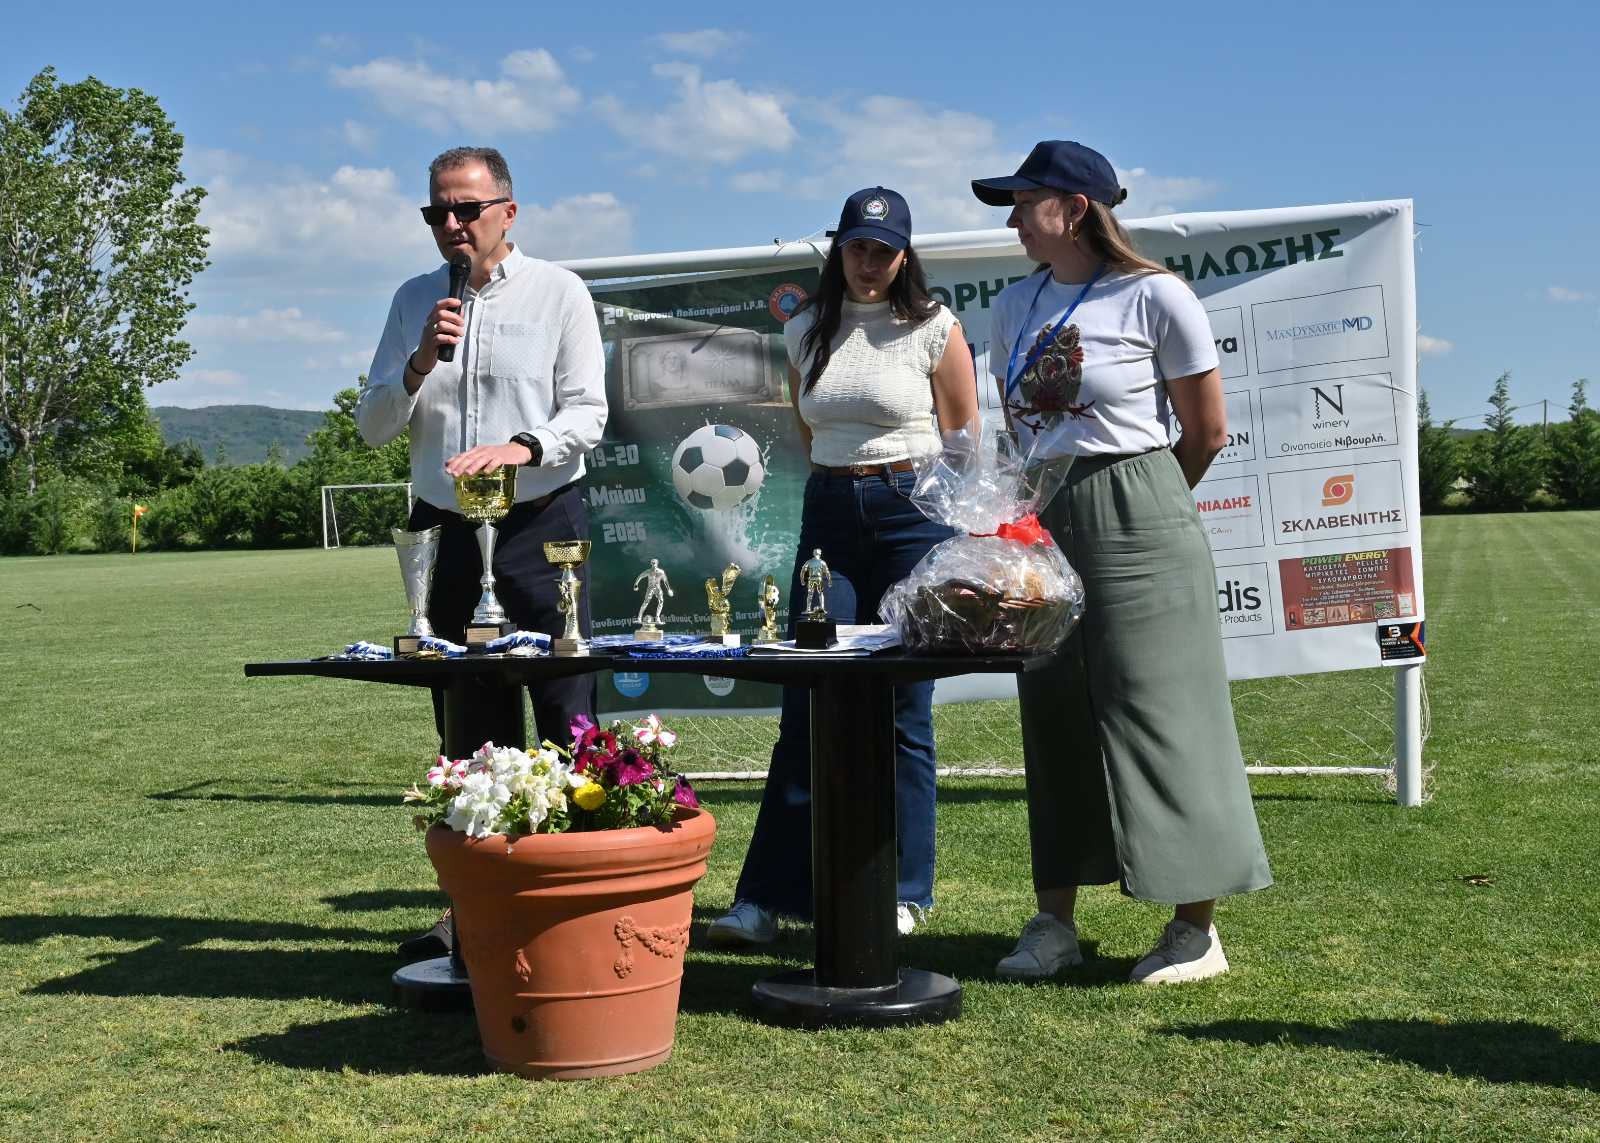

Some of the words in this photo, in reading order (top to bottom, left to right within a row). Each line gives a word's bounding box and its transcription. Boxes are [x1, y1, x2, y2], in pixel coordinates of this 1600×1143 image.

[927, 275, 1030, 311] ΟΡΗ
[1164, 229, 1344, 282] ΗΛΩΣΗΣ
[1312, 419, 1350, 431] winery
[1196, 495, 1252, 513] ΝΙΑΔΗΣ
[1282, 509, 1402, 533] ΣΚΛΑΒΕΝΙΤΗΣ
[1302, 554, 1343, 566] POWER
[1344, 550, 1390, 562] ENERGY
[1218, 580, 1262, 613] dis
